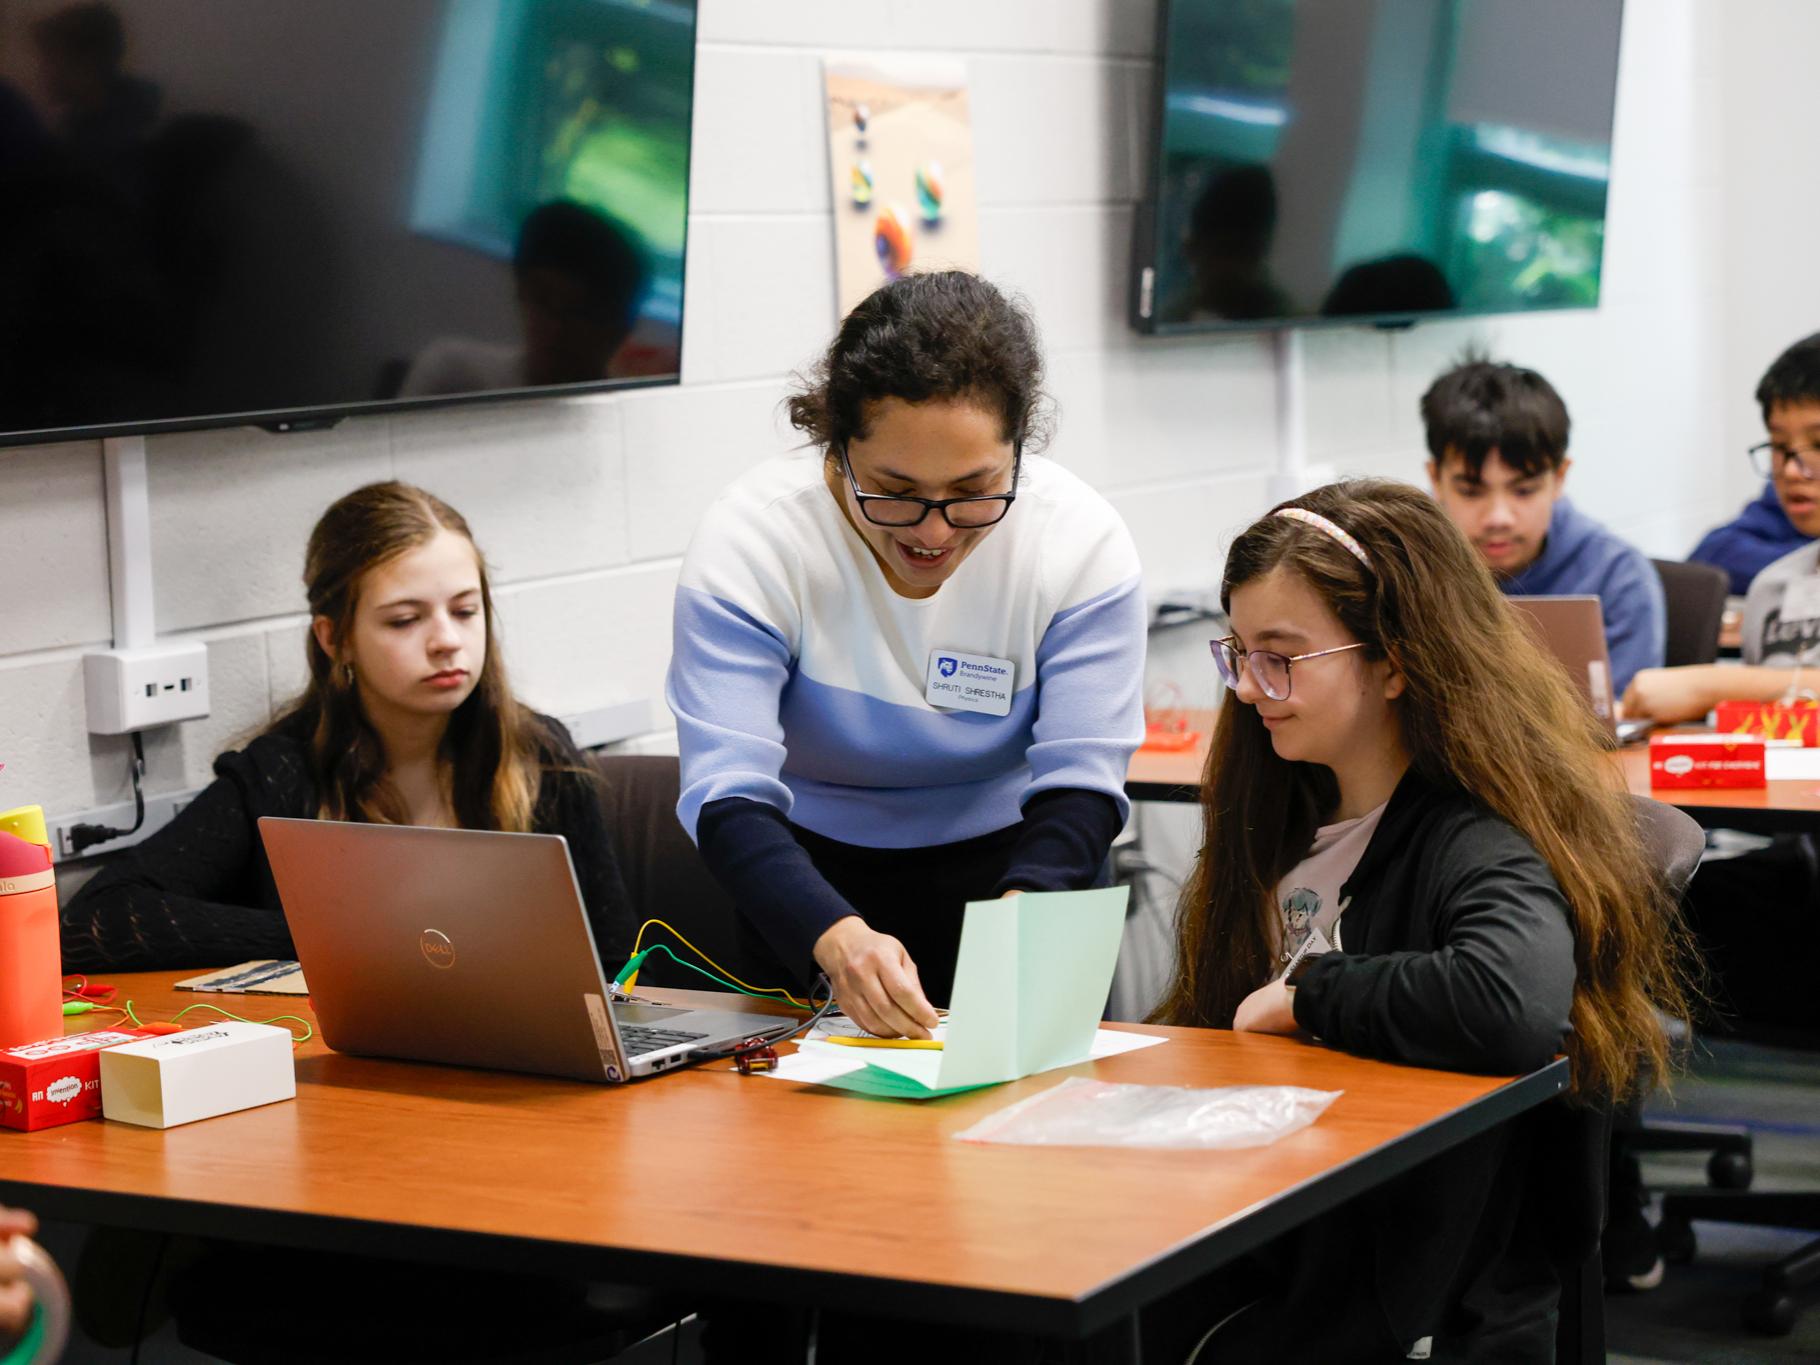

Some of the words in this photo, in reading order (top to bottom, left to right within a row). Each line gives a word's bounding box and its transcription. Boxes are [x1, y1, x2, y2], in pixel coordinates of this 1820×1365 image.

[932, 681, 961, 693] SHRUTI
[965, 686, 1006, 700] SHRESTHA
[85, 1080, 99, 1091] KIT
